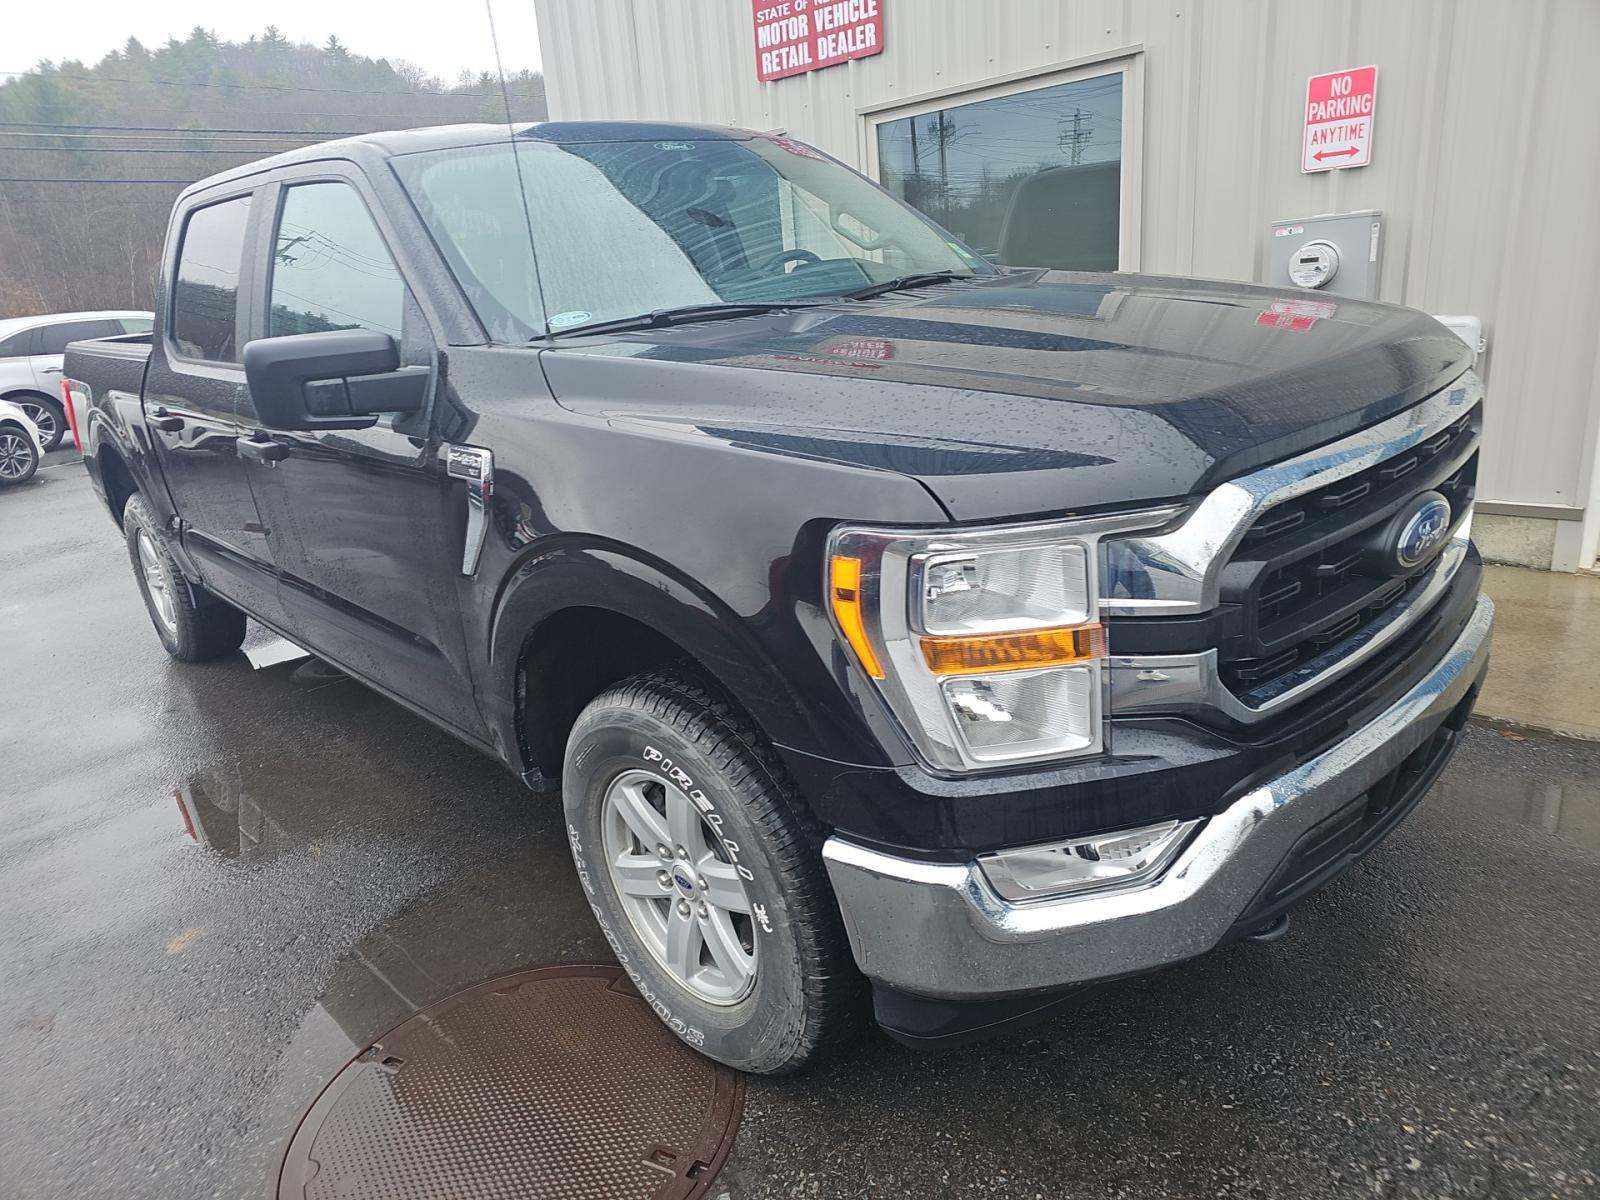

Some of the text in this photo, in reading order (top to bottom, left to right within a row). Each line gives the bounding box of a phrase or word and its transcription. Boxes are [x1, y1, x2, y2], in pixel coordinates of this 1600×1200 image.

[757, 0, 808, 23] STATE OF
[758, 0, 878, 48] MOTOR VEHICLE
[761, 22, 876, 75] RETAIL DEALER
[1330, 75, 1352, 97] NO
[1308, 93, 1372, 121] PARKING
[1311, 122, 1365, 146] ANYTIME
[643, 745, 754, 881] PIRELLI
